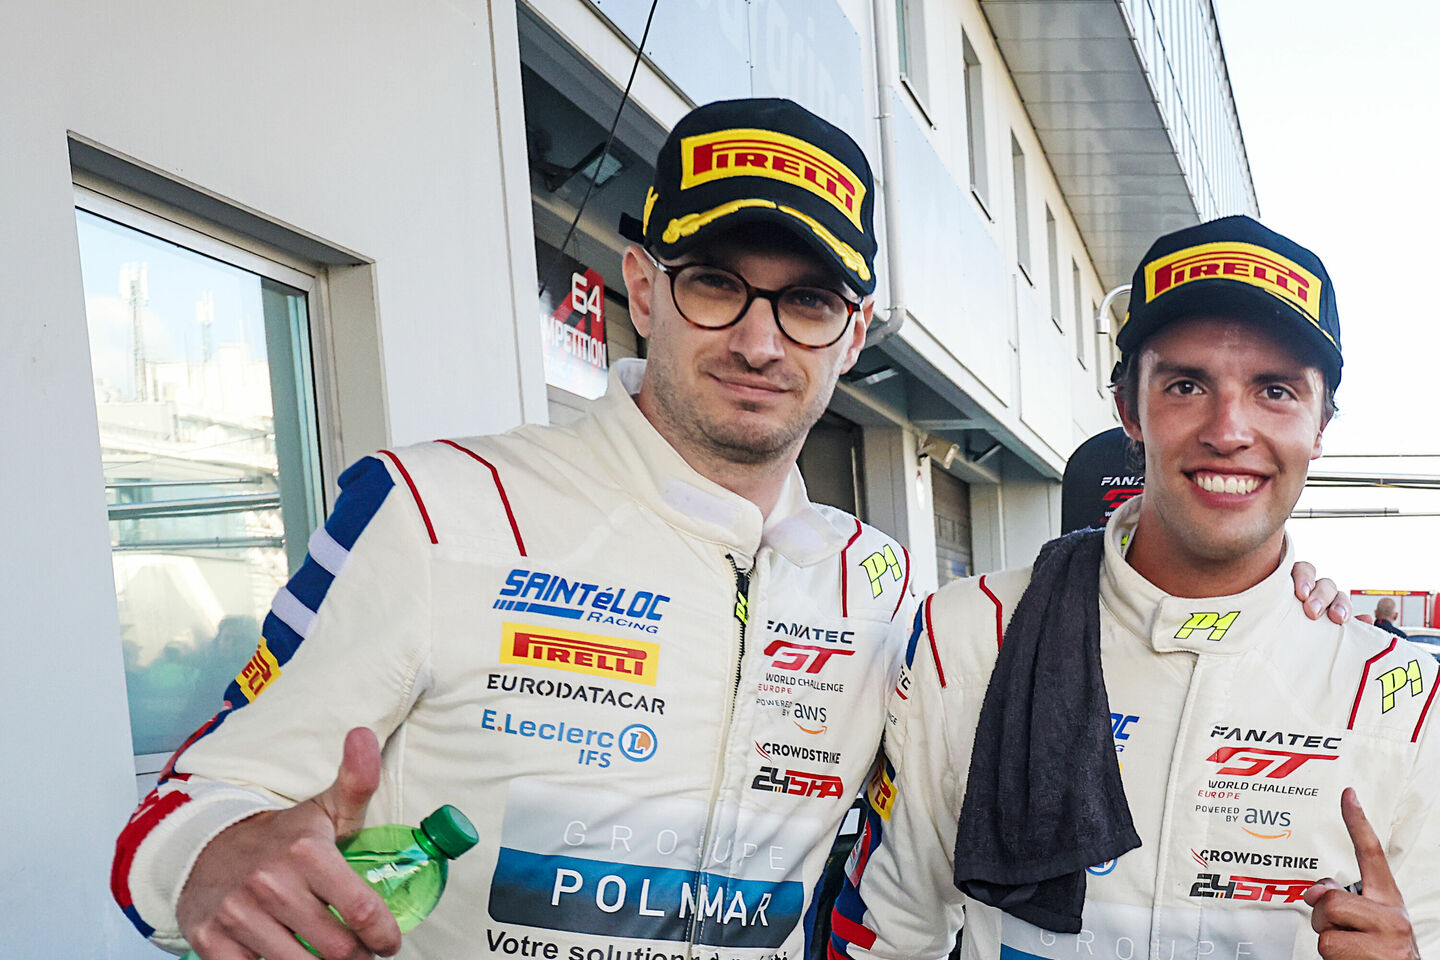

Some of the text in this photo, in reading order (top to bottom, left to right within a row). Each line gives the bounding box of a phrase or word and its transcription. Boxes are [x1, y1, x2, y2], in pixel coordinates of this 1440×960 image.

[693, 138, 857, 215] PIRELLI
[1154, 248, 1310, 302] PIRELLI
[571, 272, 602, 322] 64
[586, 611, 659, 635] RACING
[766, 620, 855, 645] FANATEC
[512, 631, 648, 677] PIRELLI
[486, 673, 666, 716] EURODATACAR
[757, 683, 793, 695] EUROPE
[765, 672, 845, 693] WORLD CHALLENGE
[755, 697, 793, 709] POWERED
[781, 708, 790, 717] BY
[794, 702, 827, 723] aws
[480, 708, 615, 749] E.Leclerc
[1210, 725, 1343, 750] FANATEC
[578, 748, 613, 769] IFS
[761, 741, 842, 765] CROWDSTRIKE
[1197, 789, 1241, 800] EUROPE
[1208, 779, 1319, 798] WORLD CHALLENGE
[1195, 803, 1240, 815] POWERED
[1225, 814, 1239, 823] BY
[1243, 806, 1292, 828] aws
[562, 819, 787, 871] GROUPE
[1199, 848, 1319, 870] CROWDSTRIKE
[550, 867, 773, 928] POLMAR
[486, 928, 560, 960] Votre
